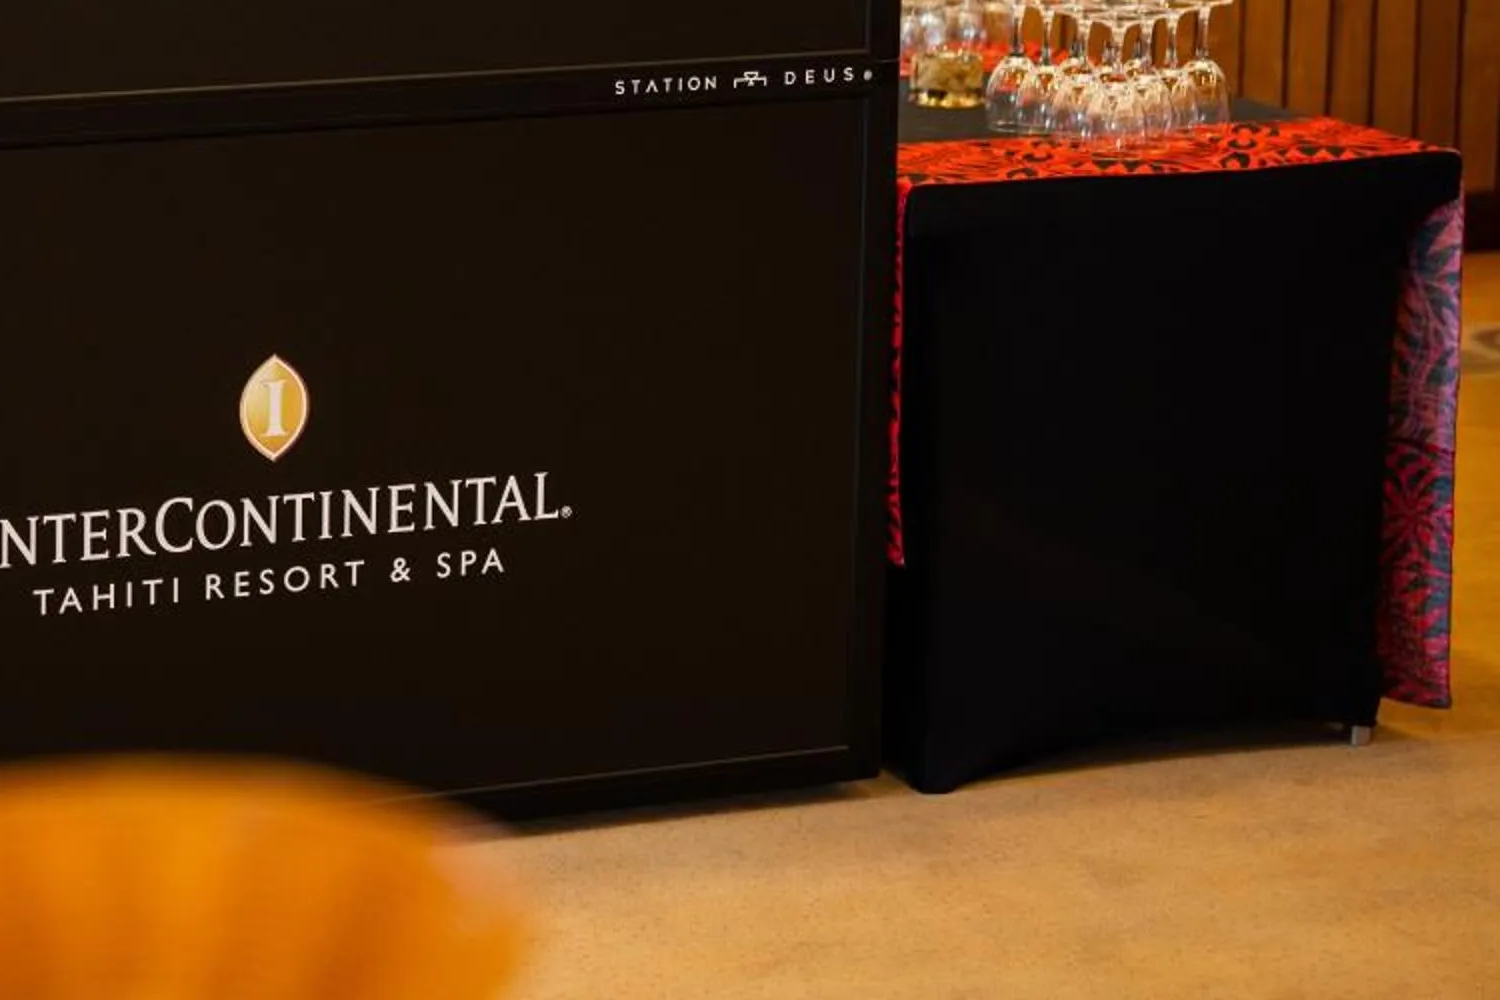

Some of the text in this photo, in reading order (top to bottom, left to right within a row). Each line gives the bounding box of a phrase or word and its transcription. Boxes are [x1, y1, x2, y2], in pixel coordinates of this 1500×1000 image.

[614, 66, 855, 95] STATION DEUS
[32, 547, 505, 616] TAHITI RESORT & SPA
